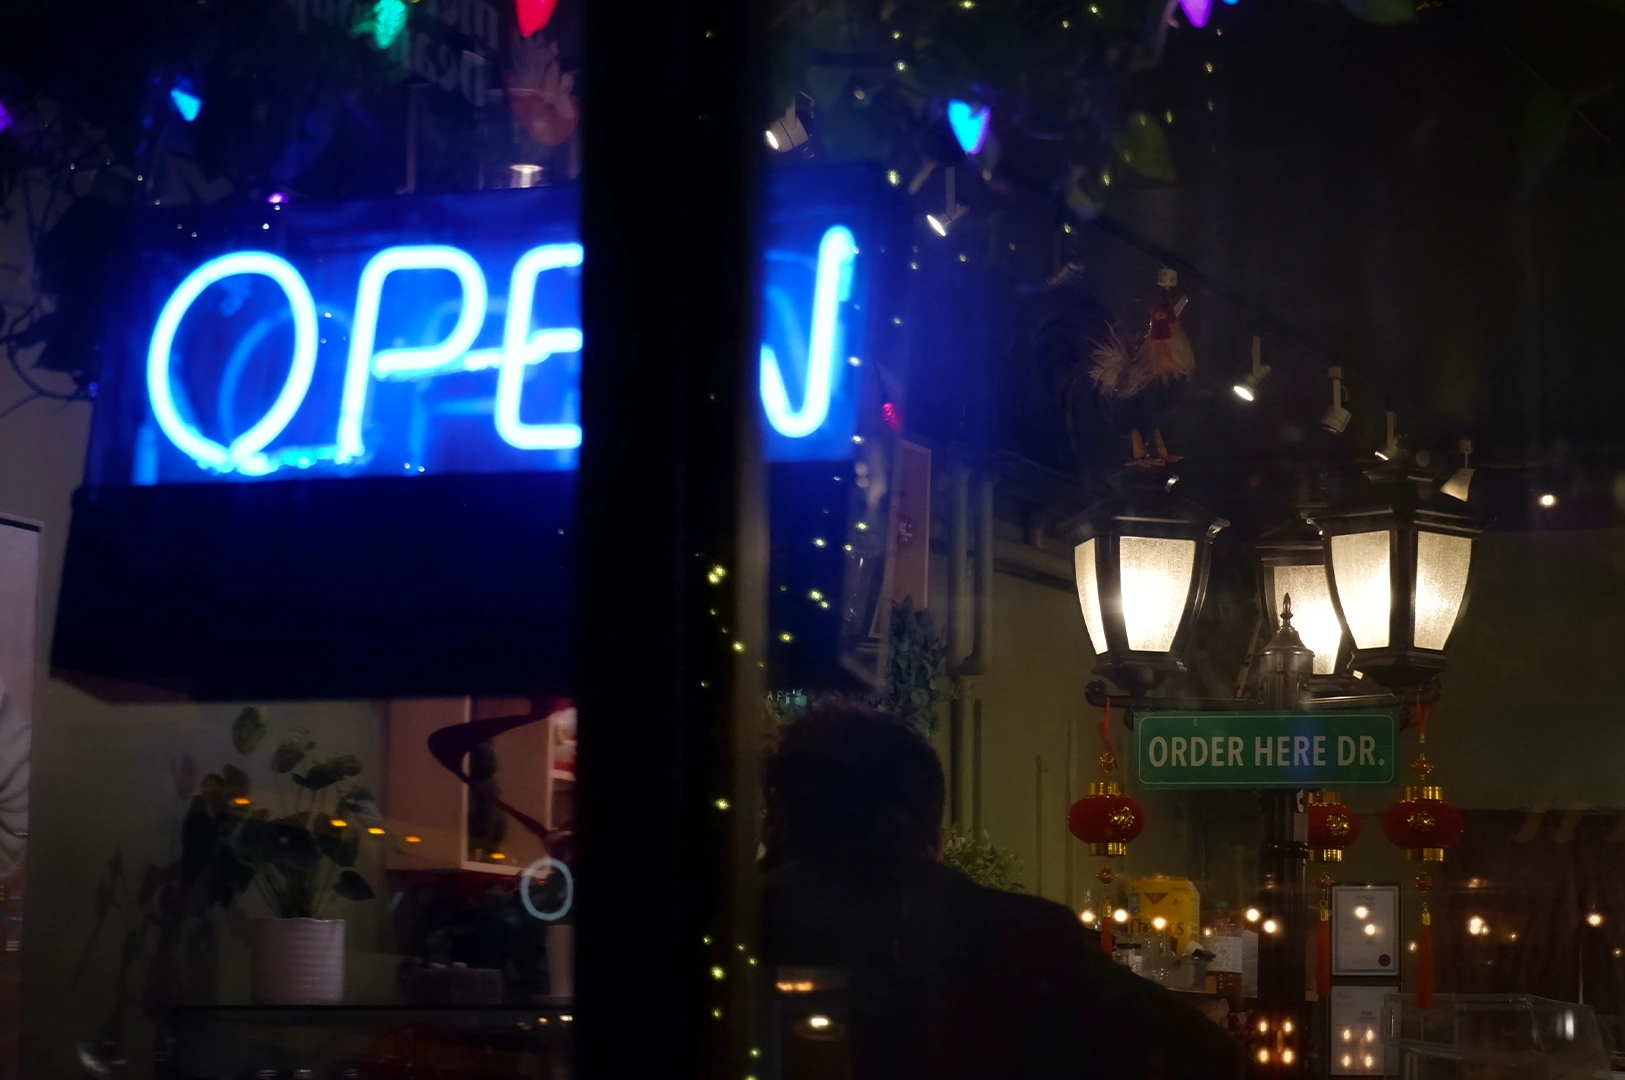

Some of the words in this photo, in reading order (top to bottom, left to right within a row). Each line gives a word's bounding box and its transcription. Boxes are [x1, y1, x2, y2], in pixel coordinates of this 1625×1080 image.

[1149, 736, 1244, 768] ORDER
[1255, 735, 1326, 767] HERE
[1337, 735, 1386, 767] DR.
